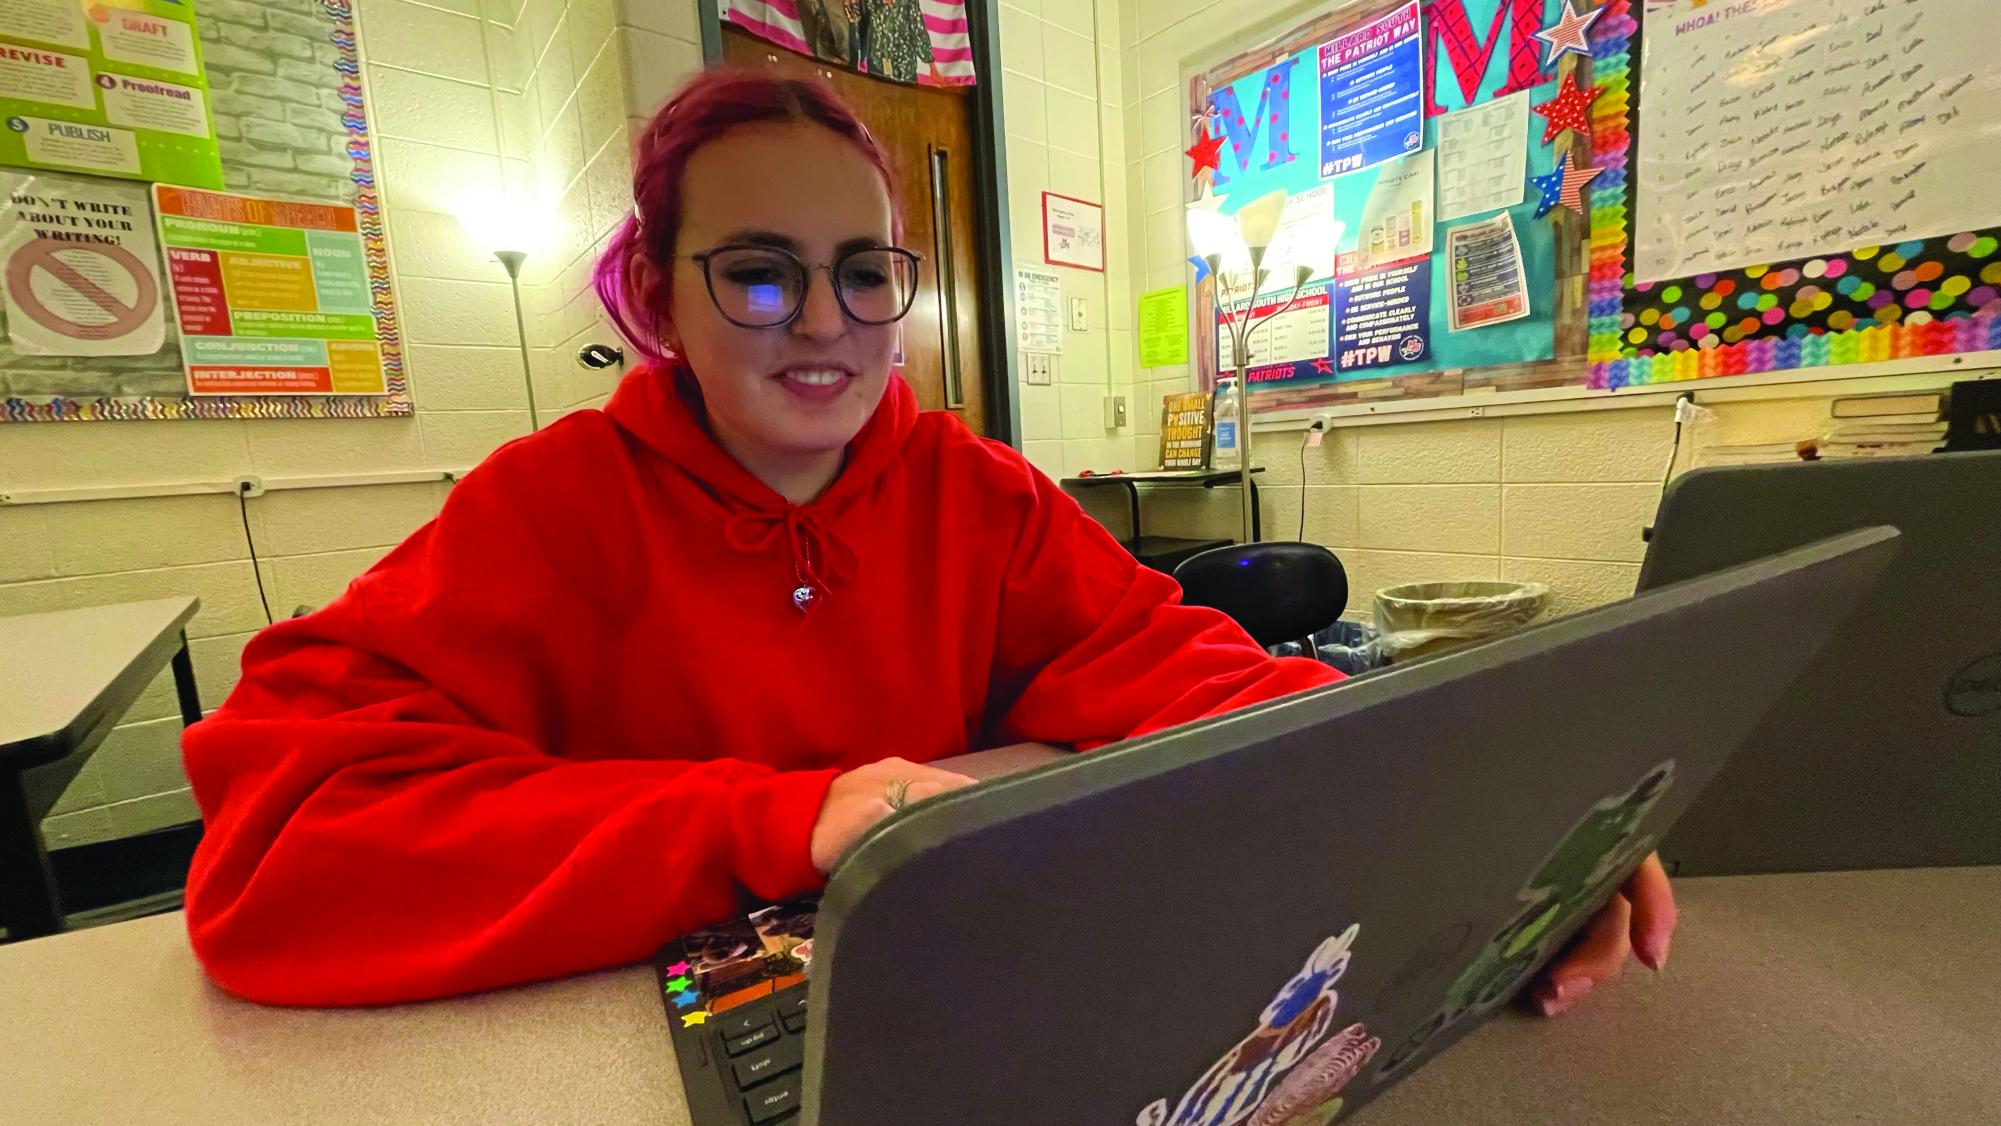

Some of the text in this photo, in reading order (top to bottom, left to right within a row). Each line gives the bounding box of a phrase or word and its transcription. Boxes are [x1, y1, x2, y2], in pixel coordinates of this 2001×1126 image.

[122, 18, 168, 37] DRAFT
[1675, 11, 1720, 36] WHOA!
[1325, 28, 1372, 56] MILLARD
[1376, 8, 1411, 34] SOUTH
[1321, 52, 1342, 69] THE
[1345, 31, 1390, 60] PATRIOT
[1393, 18, 1416, 38] WAY
[0, 47, 66, 68] REVISE
[122, 79, 191, 101] Proofread
[48, 123, 111, 143] PUBLISH
[1322, 153, 1363, 176] #TPW
[11, 193, 133, 217] DON'T WRITE
[17, 211, 133, 232] ABOUT YOUR
[34, 229, 121, 245] WRITING!
[170, 250, 212, 264] VERB
[313, 248, 351, 258] NOUN
[1297, 286, 1328, 299] SCHOOL
[1382, 286, 1406, 297] PEOPLE
[233, 311, 326, 323] PREPOSITION
[1389, 306, 1416, 318] CLEARLY
[1359, 313, 1415, 329] COMPASSIONATELY
[194, 341, 298, 353] CONJUNCTION
[1341, 345, 1392, 368] #TPW
[193, 370, 297, 380] INTERJECTION
[1248, 367, 1295, 382] PATRIOTS
[1168, 400, 1181, 413] ONE
[1167, 426, 1203, 441] THOUGHT
[1166, 447, 1201, 458] CAN CHANGE
[764, 1090, 790, 1106] enter
